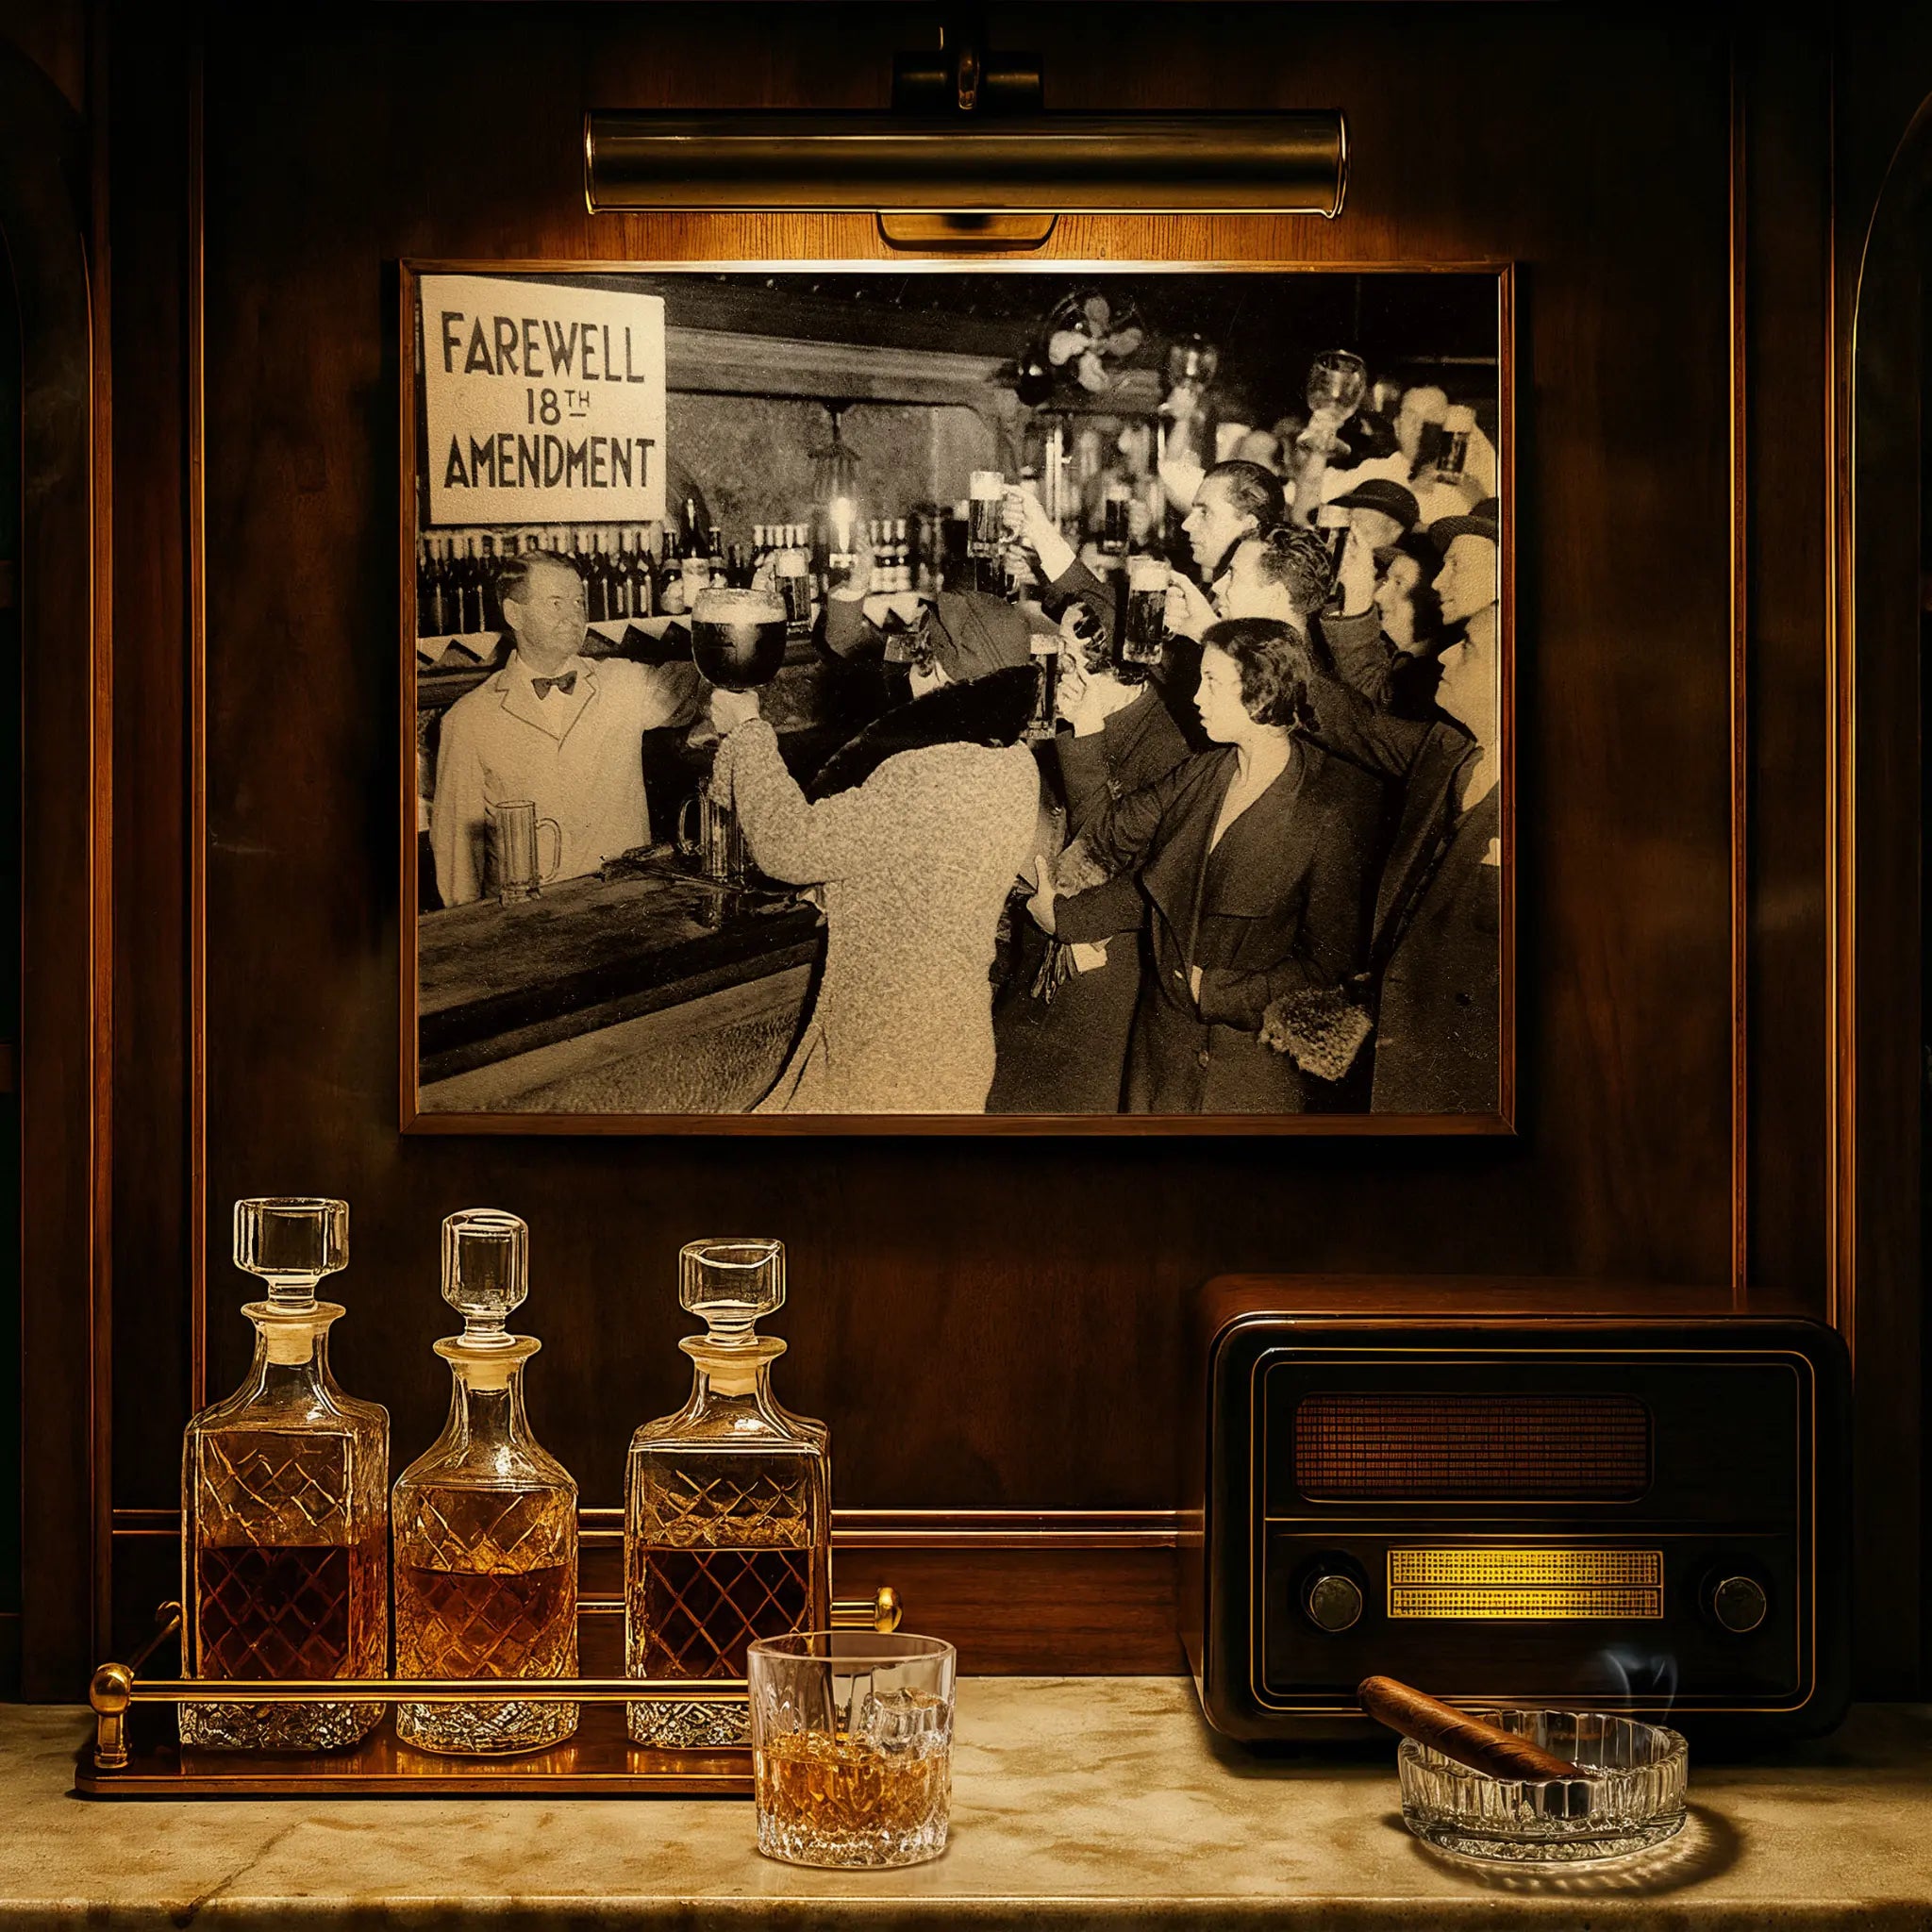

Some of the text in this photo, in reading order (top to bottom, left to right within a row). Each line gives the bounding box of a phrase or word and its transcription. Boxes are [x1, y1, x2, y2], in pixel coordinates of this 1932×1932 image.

[441, 310, 645, 383] FAREWELL
[525, 388, 590, 425] 18TH
[443, 432, 656, 489] AMENDMENT
